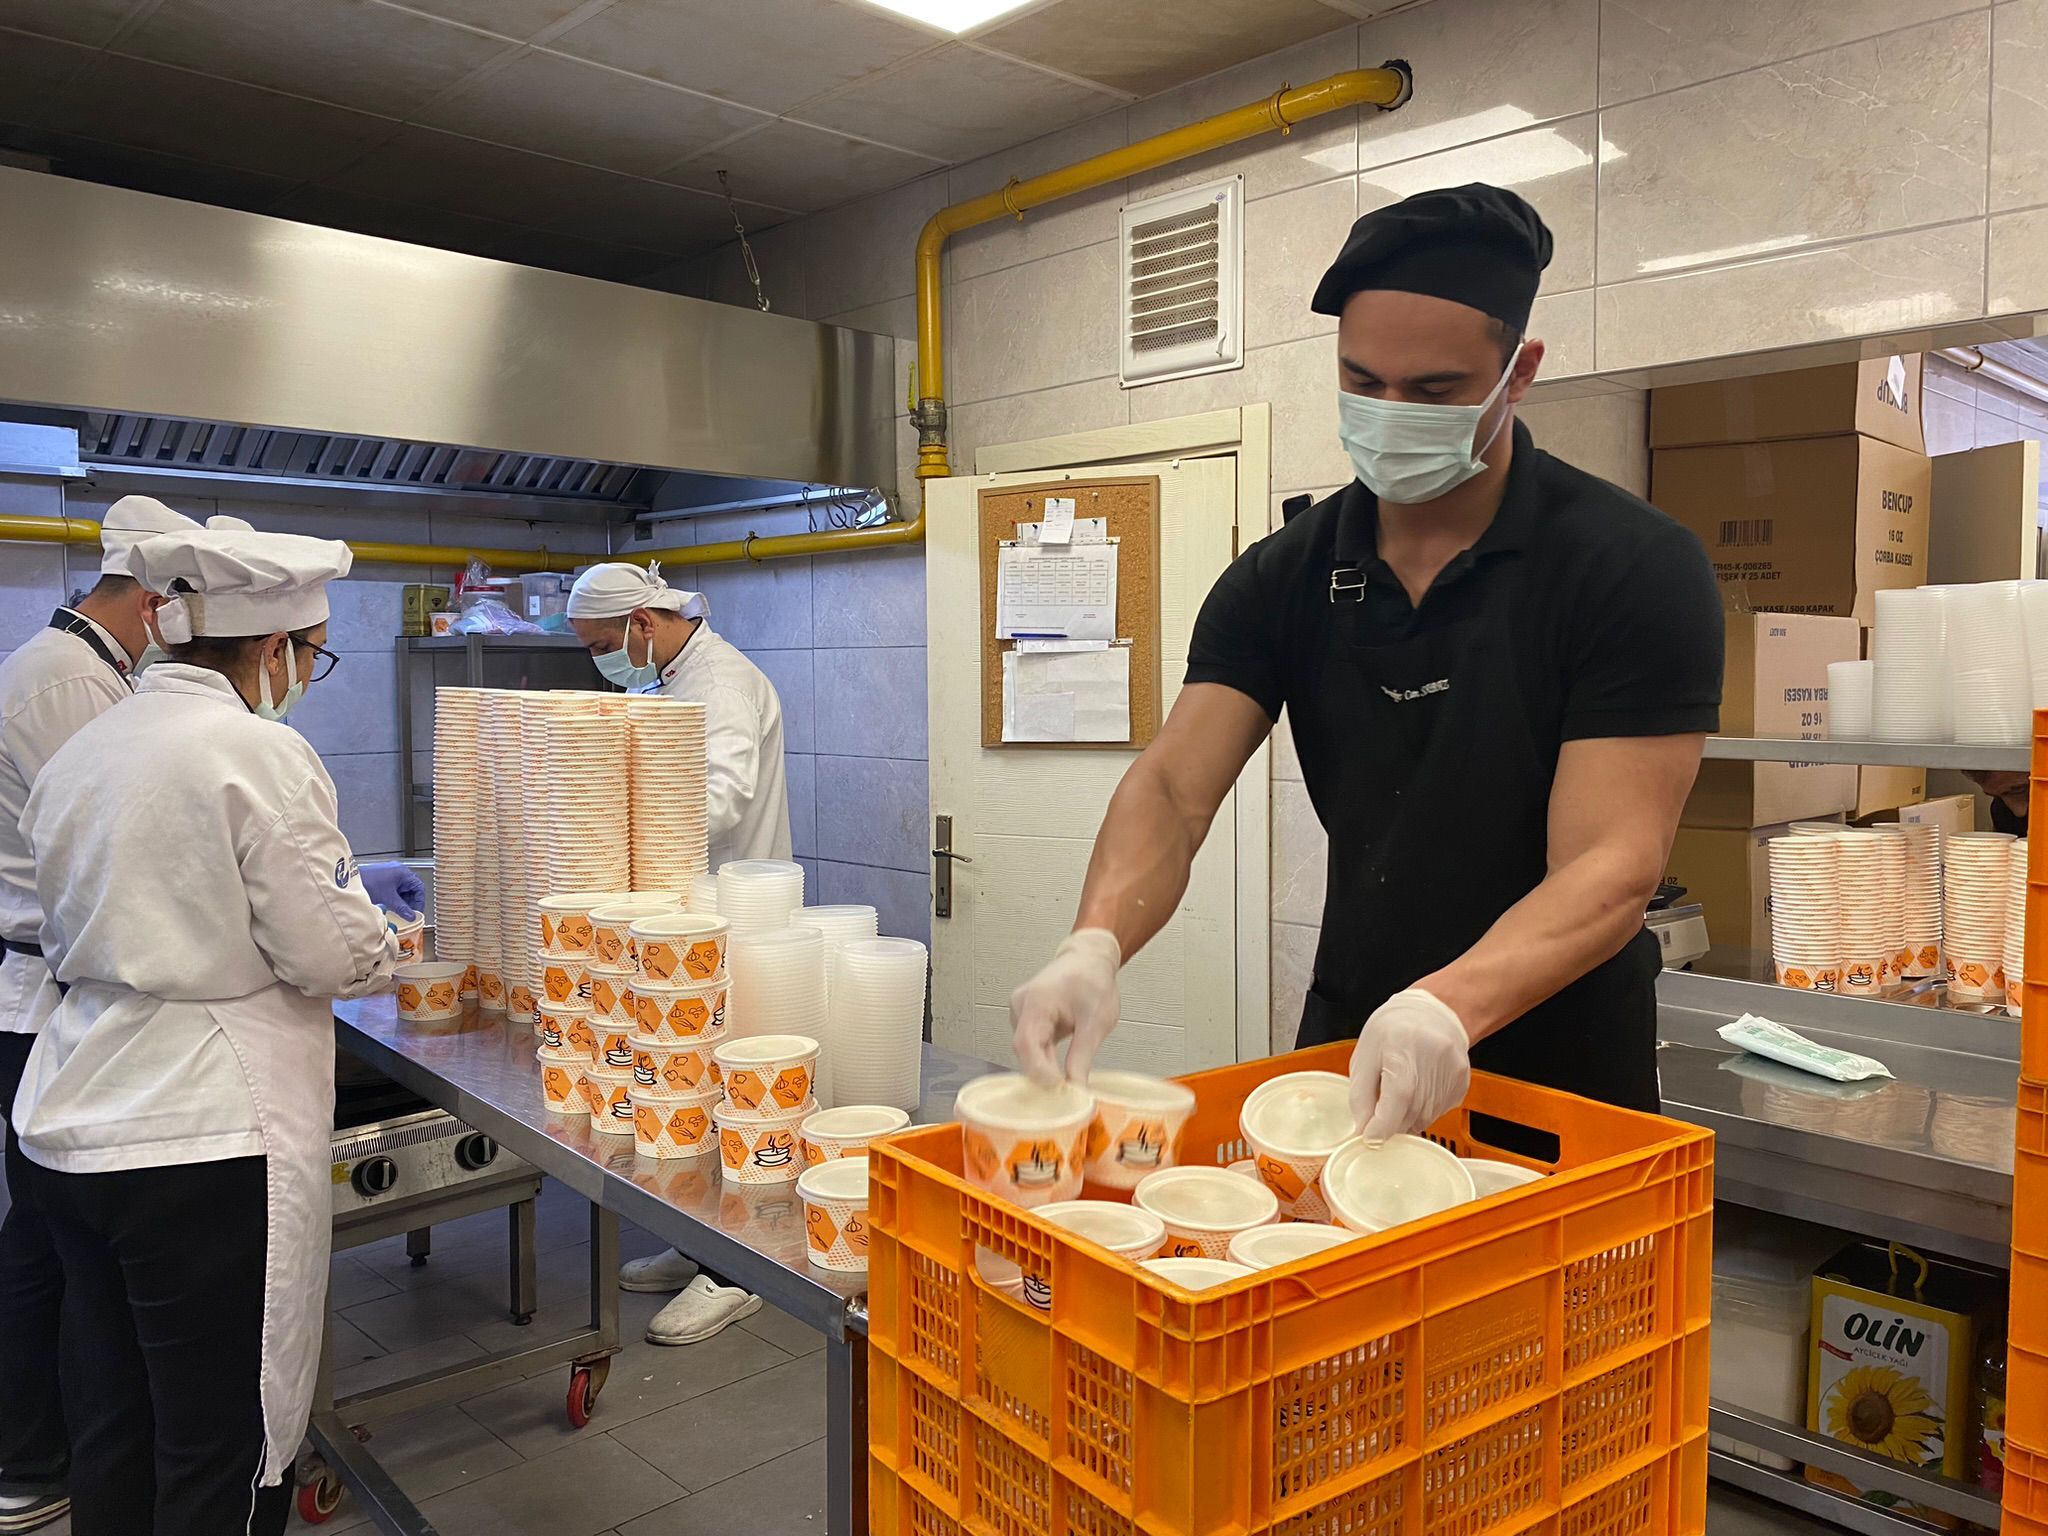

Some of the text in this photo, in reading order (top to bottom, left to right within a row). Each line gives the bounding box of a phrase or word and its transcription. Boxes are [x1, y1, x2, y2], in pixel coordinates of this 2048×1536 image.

[1882, 490, 1913, 514] BENCUP
[1896, 531, 1903, 543] OZ
[1875, 550, 1913, 567] ÇORBA KASESİ
[1748, 572, 1759, 580] 25
[1760, 571, 1781, 580] ADET
[1763, 604, 1785, 612] KASE
[1790, 605, 1805, 613] 500
[1806, 604, 1835, 613] KAPAK
[1784, 688, 1828, 706] RBA KASESİ
[1801, 712, 1823, 726] 16 OZ
